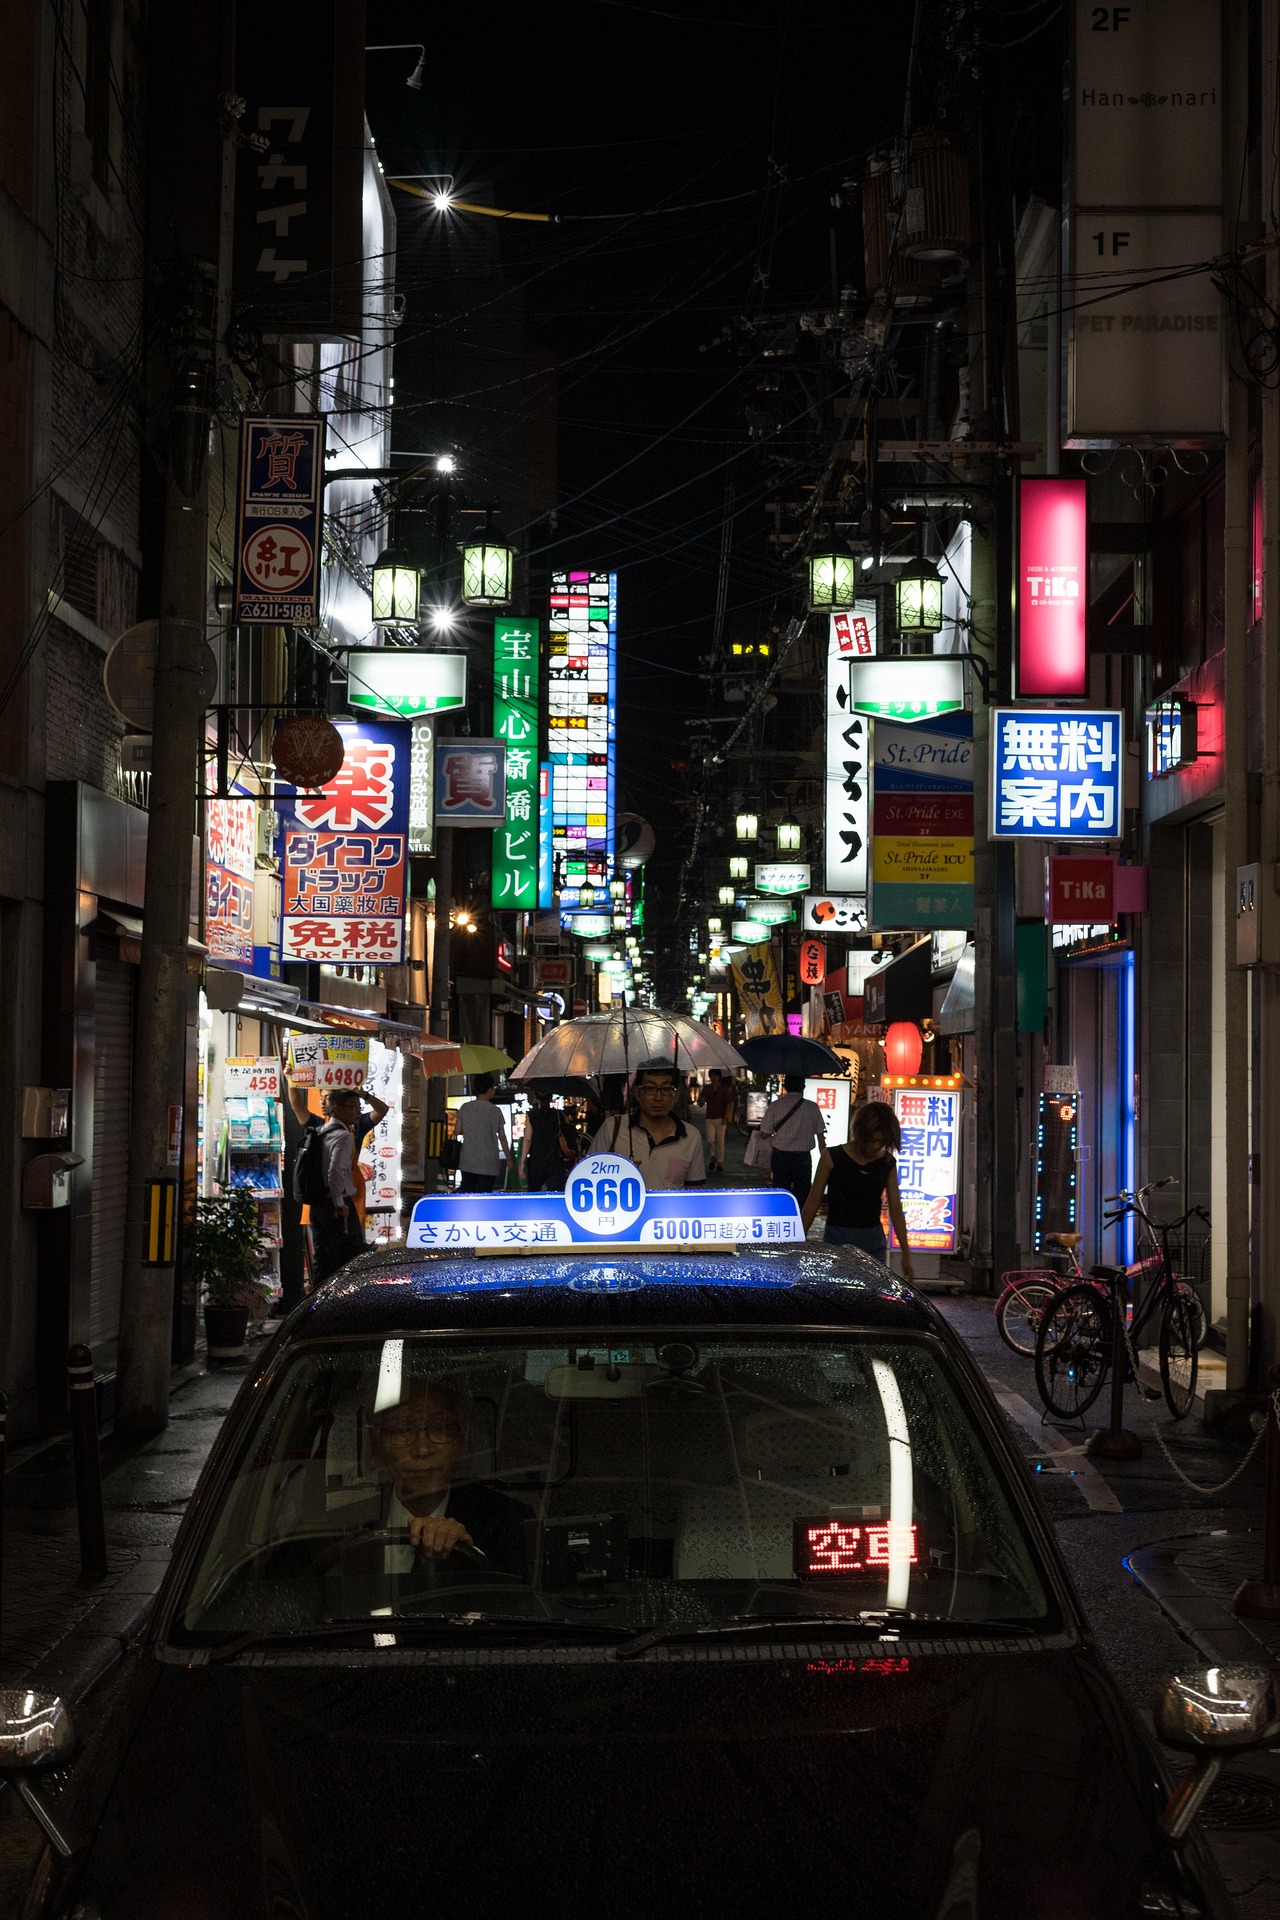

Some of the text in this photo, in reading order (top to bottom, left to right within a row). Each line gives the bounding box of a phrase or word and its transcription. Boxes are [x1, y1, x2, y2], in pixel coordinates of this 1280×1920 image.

[1092, 8, 1130, 31] 2F
[1082, 88, 1216, 106] Han nari
[256, 106, 312, 283] ワカイケ
[1093, 232, 1130, 256] 1F
[1078, 315, 1218, 332] PET PARADISE
[256, 432, 309, 490] 質
[255, 536, 300, 579] 紅
[1027, 576, 1079, 597] TiKa
[879, 701, 938, 714] 三ツ寺筋
[882, 743, 970, 765] St.Pride
[1002, 720, 1117, 772] 無料
[443, 753, 497, 808] 質
[886, 804, 965, 821] St.Pride EXE
[1001, 777, 1112, 829] 案内
[289, 834, 403, 868] ダイコク
[884, 850, 966, 864] St.Pride ICU
[298, 869, 386, 894] ドラッグ
[1060, 881, 1106, 899] TiKa
[288, 919, 399, 949] 免税
[295, 949, 394, 961] Tax-Free
[806, 944, 820, 981] たこ焼
[317, 1036, 367, 1051] 合利他命
[295, 1051, 318, 1063] EX
[249, 1076, 277, 1091] 458
[325, 1067, 365, 1088] 4980
[900, 1095, 954, 1127] 無料
[900, 1127, 953, 1158] 案内
[590, 1160, 620, 1175] 2km
[897, 1158, 925, 1188] 所
[571, 1177, 643, 1213] 660
[598, 1215, 616, 1227] 円
[652, 1218, 797, 1241] 5000円超分5割引
[418, 1222, 558, 1244] さかい交通
